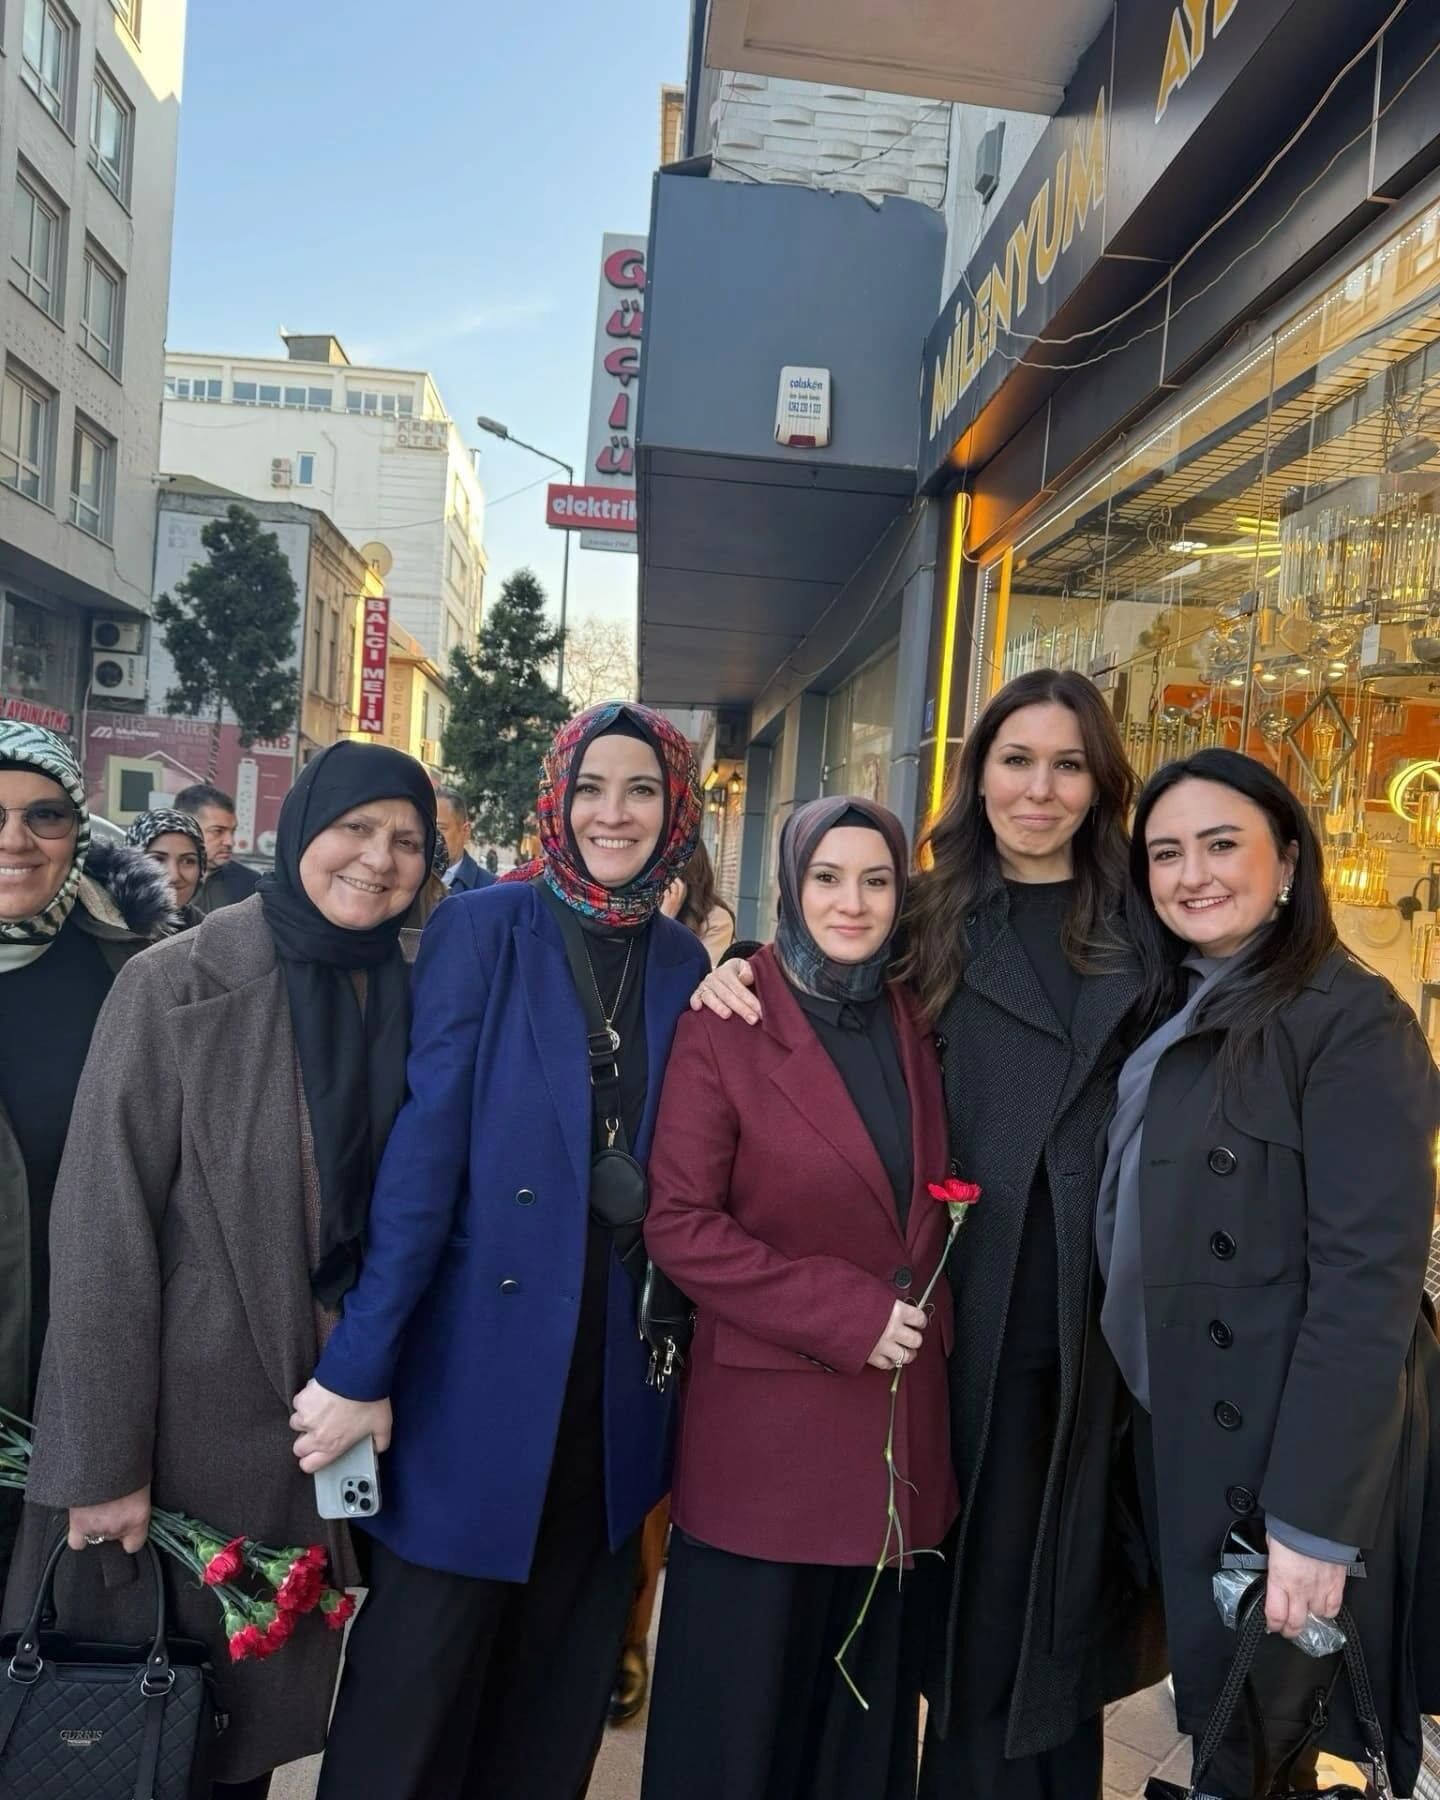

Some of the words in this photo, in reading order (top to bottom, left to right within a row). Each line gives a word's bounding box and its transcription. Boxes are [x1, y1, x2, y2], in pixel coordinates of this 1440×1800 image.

[929, 85, 1105, 441] MİLENYUM
[398, 421, 448, 433] KENT
[398, 434, 448, 448] OTEL
[360, 667, 385, 732] METİN
